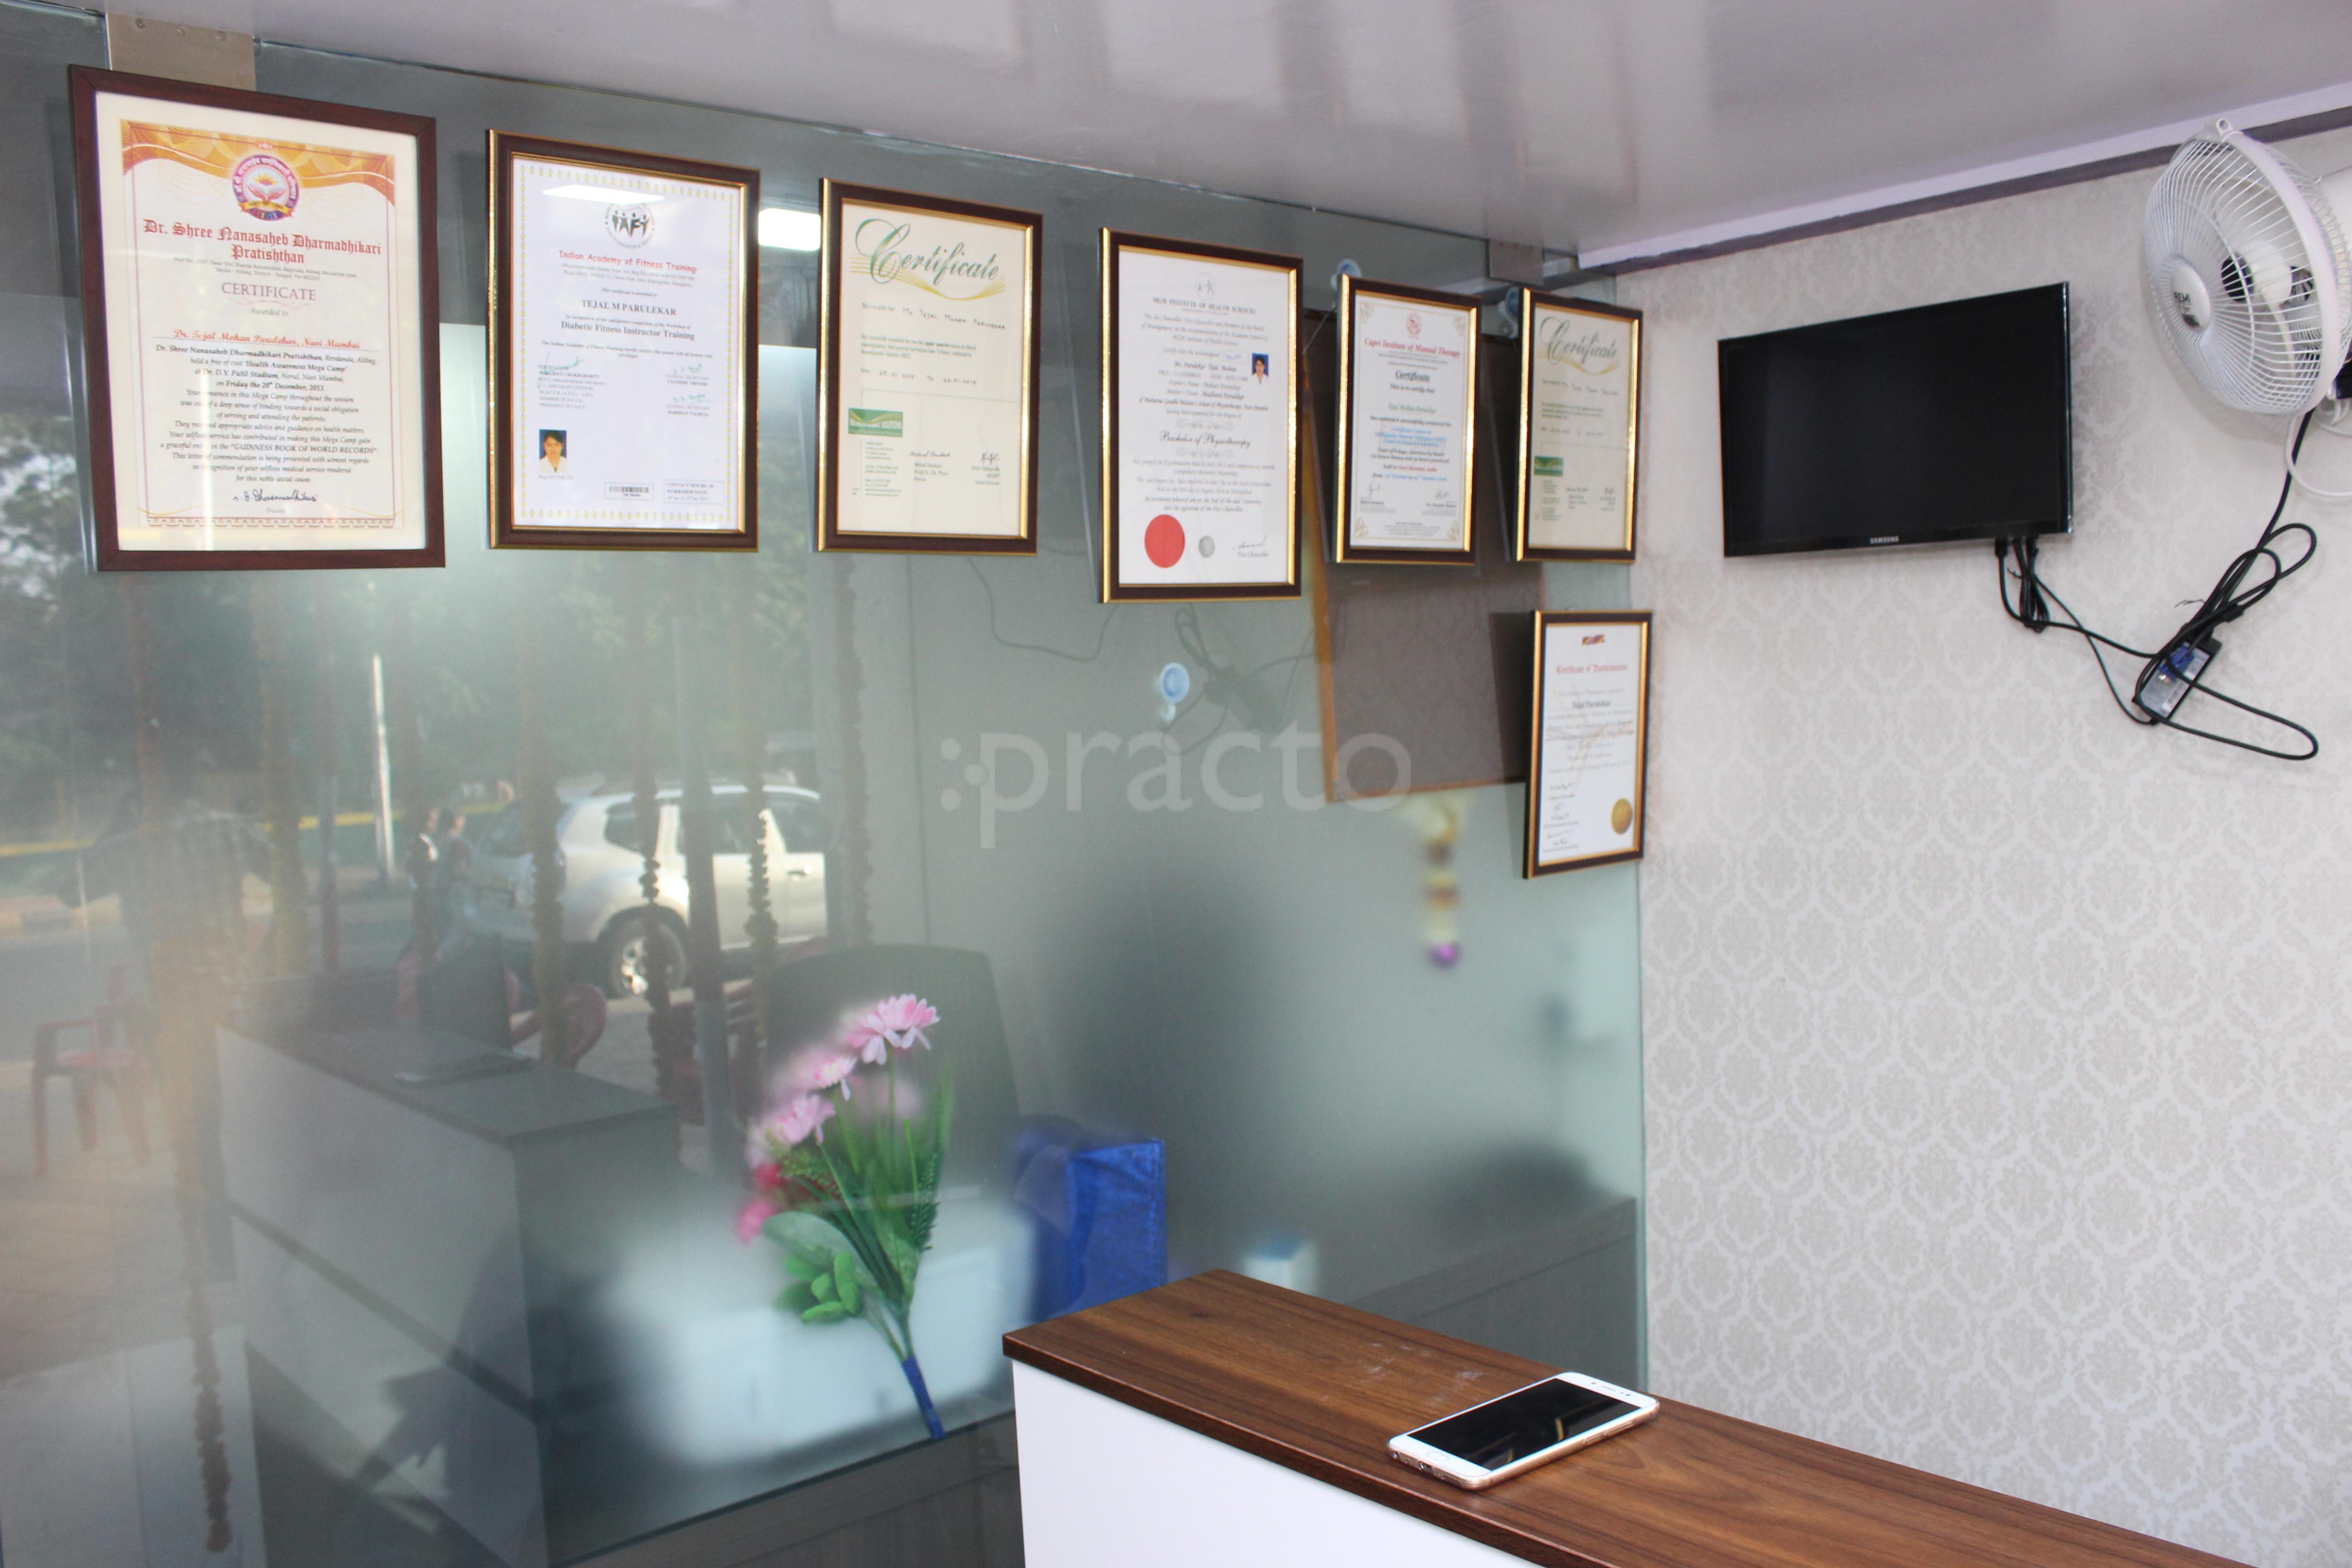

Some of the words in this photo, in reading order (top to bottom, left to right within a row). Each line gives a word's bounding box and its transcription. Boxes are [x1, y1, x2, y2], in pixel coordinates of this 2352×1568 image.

[144, 219, 167, 234] Dr.
[173, 222, 212, 238] Shree
[218, 226, 288, 245] Nanasaheb
[293, 234, 380, 255] Dharmadhikari
[232, 244, 304, 264] Pratishthan
[559, 250, 583, 260] Indian
[588, 254, 621, 265] Academy
[636, 258, 662, 269] Fitness
[855, 218, 1000, 284] Certificate
[221, 282, 315, 301] CERTIFICATE
[250, 308, 279, 316] Awarded
[582, 299, 609, 308] TEJAL
[612, 302, 620, 310] M
[622, 303, 676, 315] PARULEKAR
[192, 330, 216, 341] Tejal
[219, 332, 250, 342] Mohan
[302, 338, 322, 347] Navi
[328, 339, 359, 349] Mumbai
[561, 321, 592, 331] Diabetic
[595, 323, 621, 333] Fitness
[624, 326, 661, 336] Instructor
[664, 330, 695, 340] Training
[1540, 316, 1617, 364] Certificate
[190, 347, 228, 355] Nanasaheb
[230, 349, 281, 358] Dharmadhikari
[226, 380, 248, 389] Friday
[1396, 371, 1430, 382] Certificate
[1870, 535, 1900, 544] SAMSUNG
